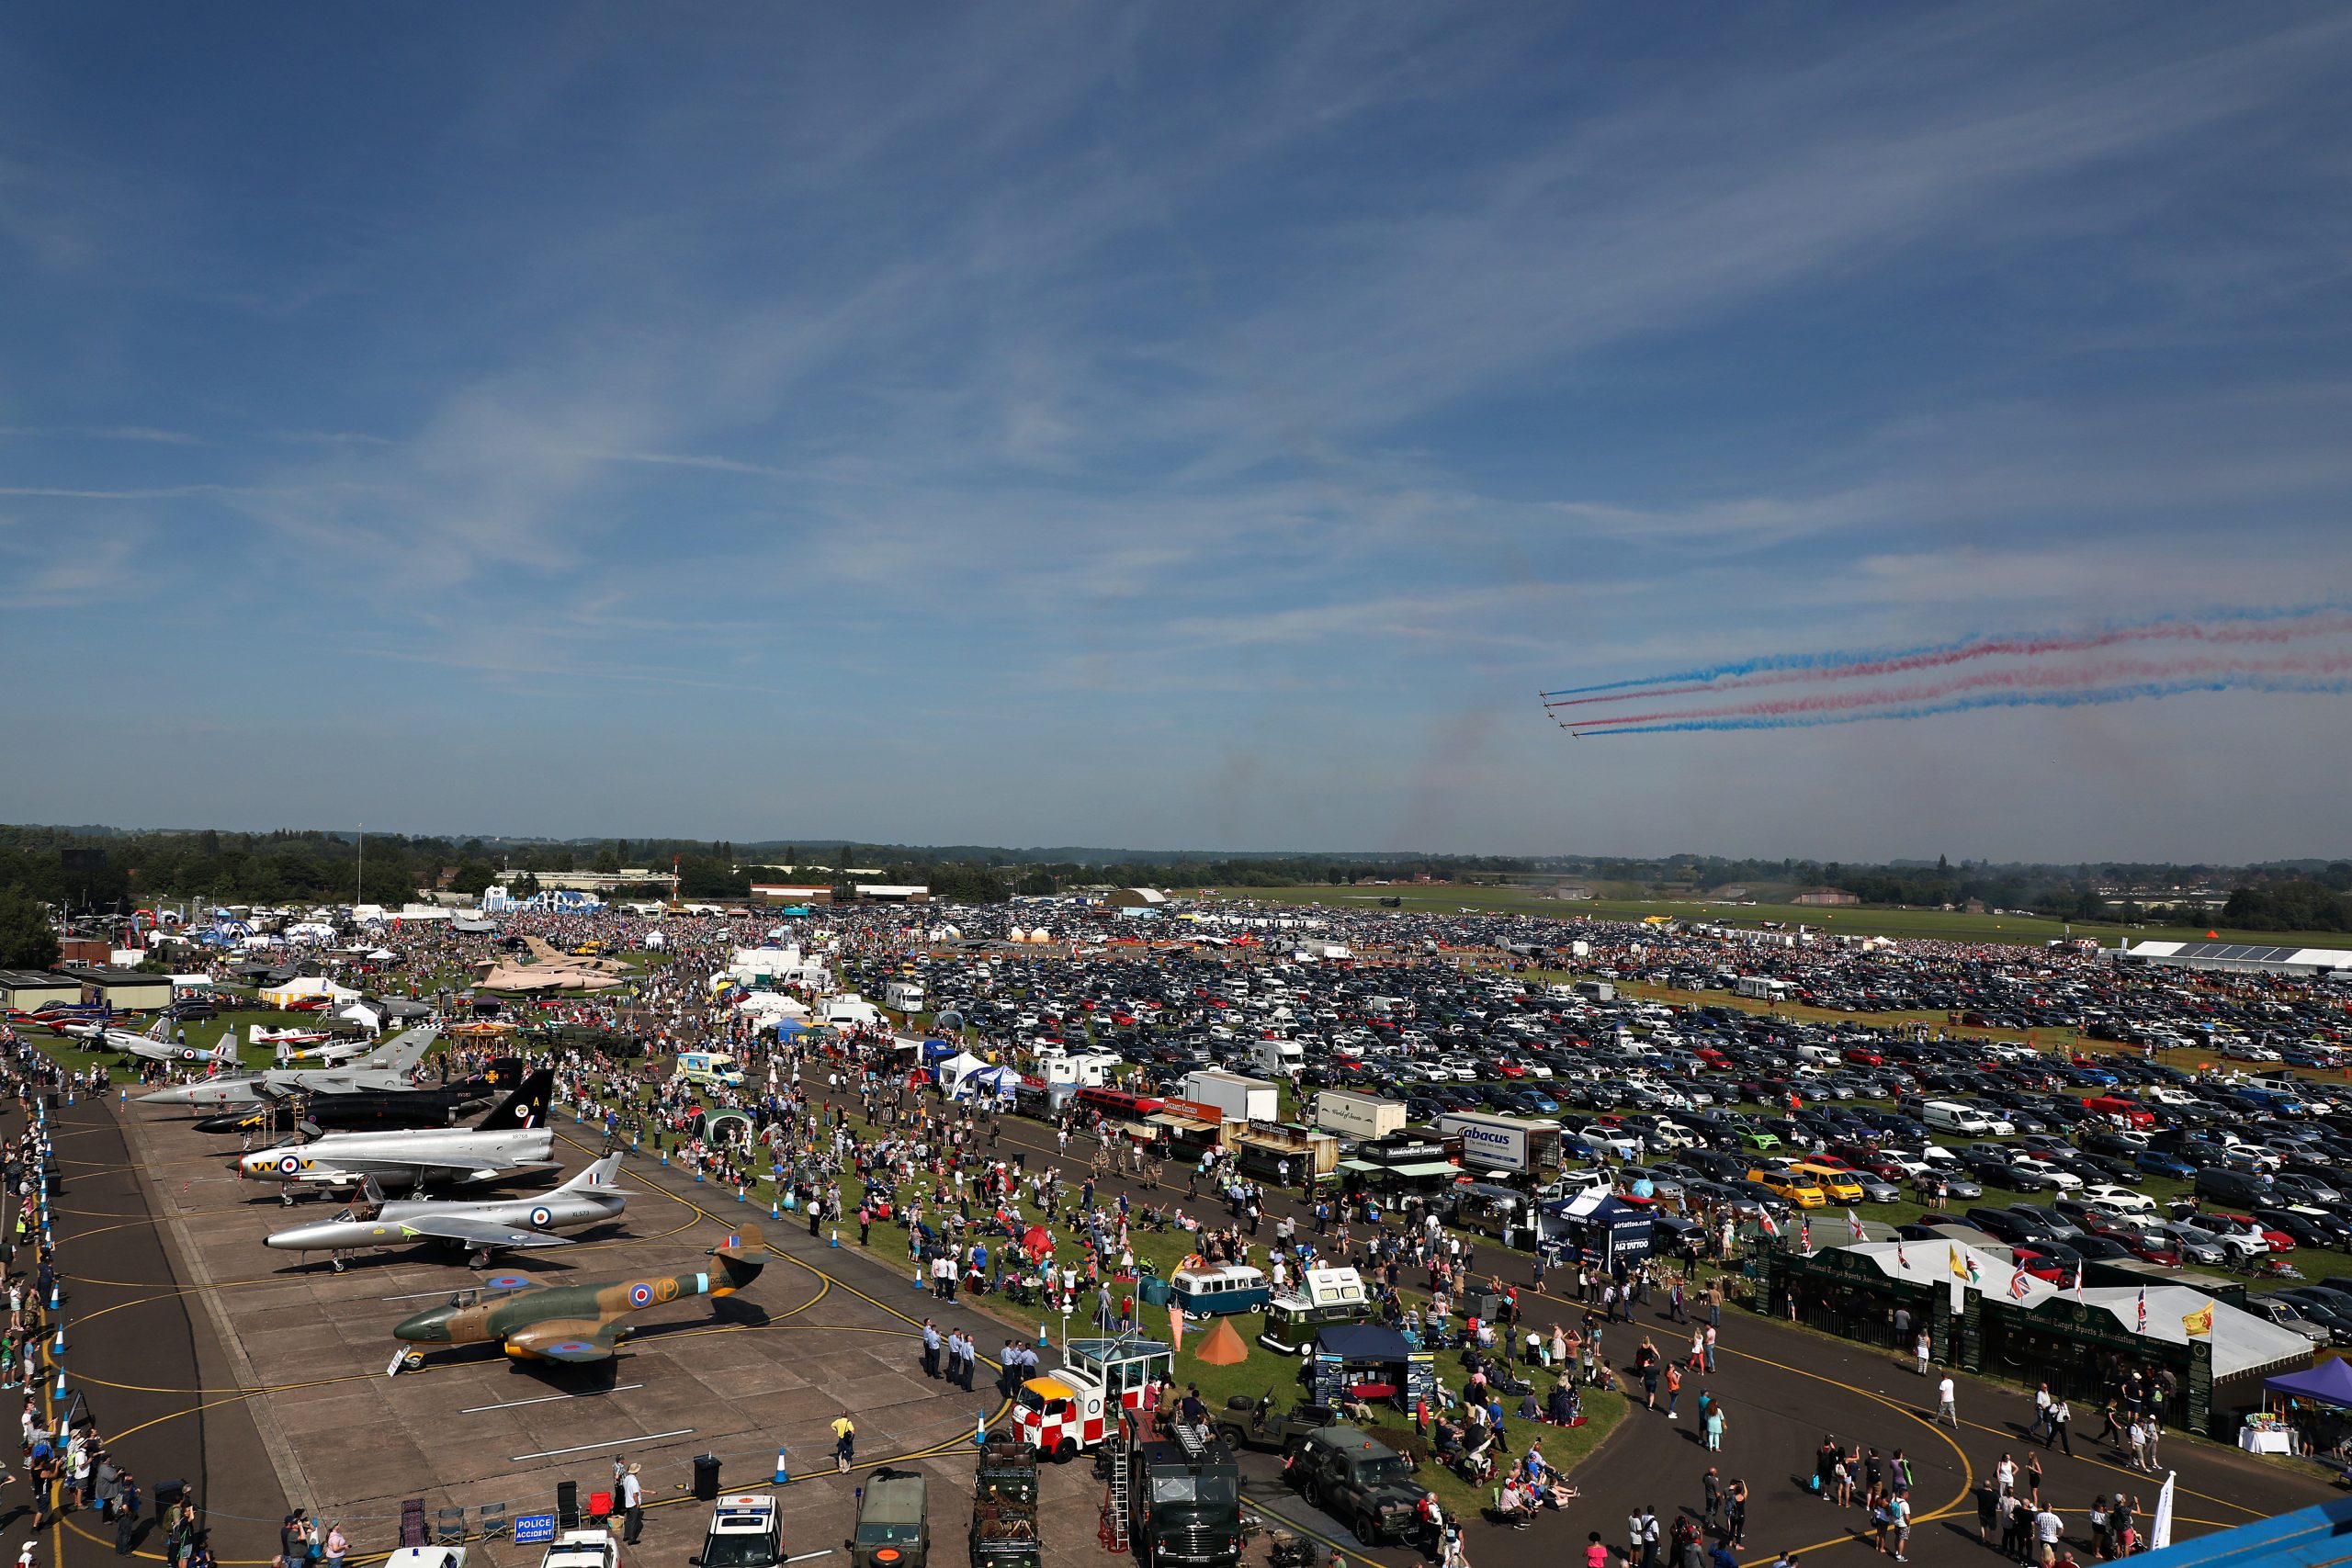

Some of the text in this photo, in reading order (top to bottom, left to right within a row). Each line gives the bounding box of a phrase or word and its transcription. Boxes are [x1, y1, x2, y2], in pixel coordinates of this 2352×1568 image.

[533, 1097, 539, 1106] A
[1331, 1109, 1343, 1118] World
[1348, 1112, 1362, 1121] Sweets
[1250, 1119, 1269, 1132] GOURMET
[1464, 1127, 1510, 1145] abacus
[1388, 1147, 1420, 1156] Handcrafted
[1560, 1213, 1569, 1221] AIR
[1569, 1214, 1588, 1224] TATTOO
[1613, 1220, 1651, 1229] airtattoo.com
[1613, 1240, 1649, 1252] AIR TATTOO
[1805, 1259, 1826, 1273] National
[1826, 1266, 1843, 1278] Target
[1844, 1269, 1861, 1282] Sports
[1861, 1273, 1893, 1289] Association
[2025, 1311, 2052, 1325] National
[2052, 1317, 2074, 1332] Target
[2075, 1323, 2098, 1336] Sports
[2098, 1328, 2137, 1346] Association
[518, 1518, 551, 1529] POLICE
[516, 1529, 552, 1539] ACCIDENT
